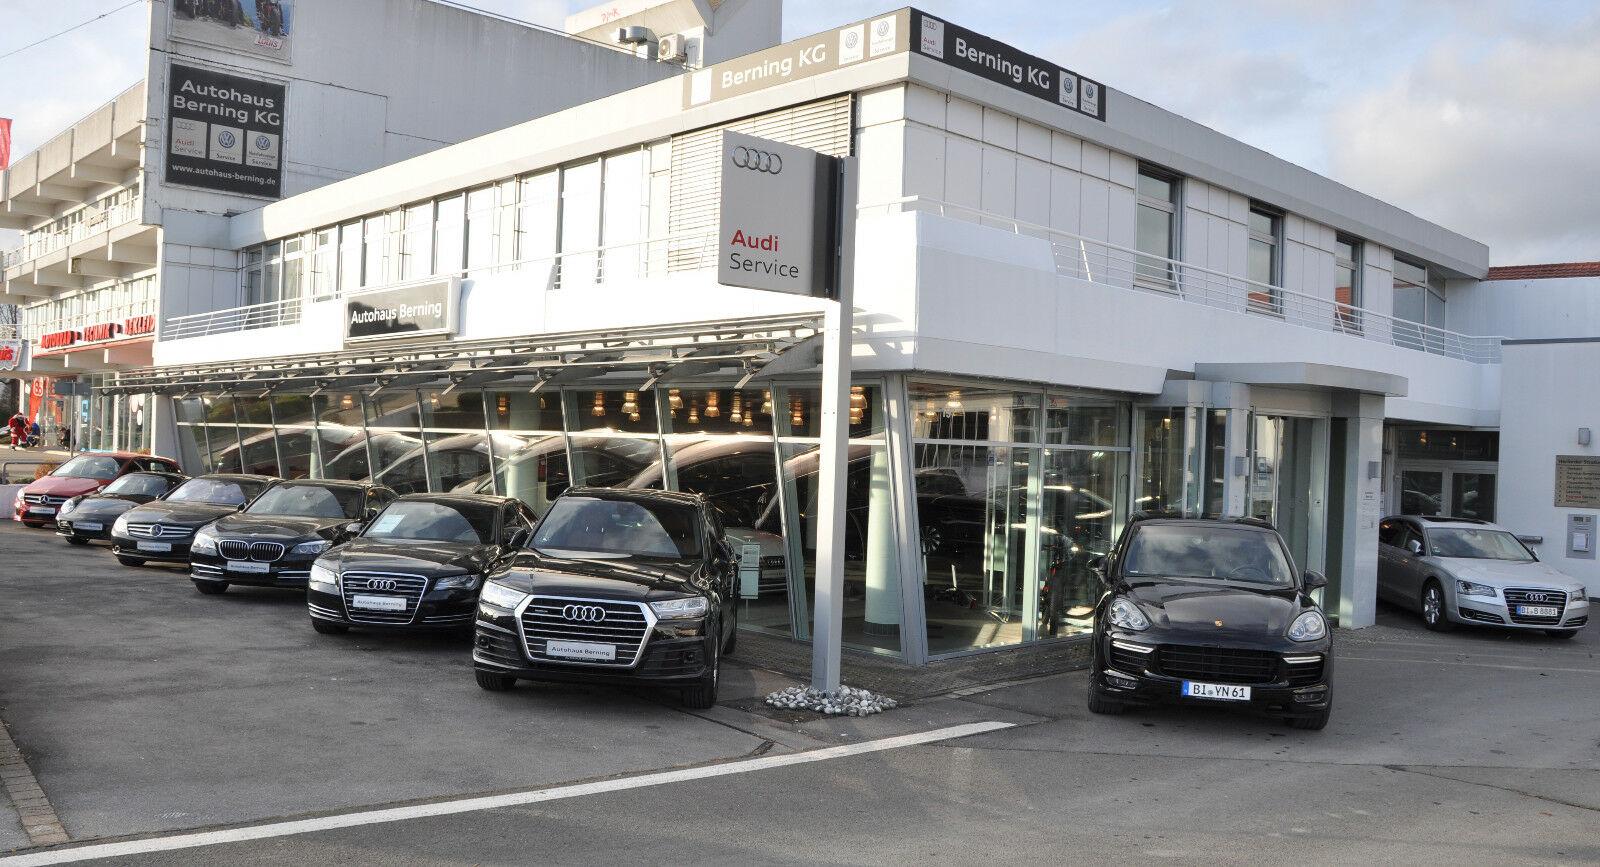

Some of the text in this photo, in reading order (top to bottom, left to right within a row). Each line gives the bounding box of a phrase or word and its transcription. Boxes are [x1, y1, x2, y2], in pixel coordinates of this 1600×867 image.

[722, 43, 826, 88] Berning KG
[955, 37, 1050, 89] Berning KG
[180, 79, 274, 108] Autohaus
[173, 95, 280, 126] Berning KG
[172, 163, 276, 186] www.autohaus-berning.de
[731, 229, 779, 252] Audi
[729, 252, 799, 279] Service
[351, 300, 441, 324] Autohaus Berning
[551, 646, 610, 657] Autohaus Berning
[1193, 684, 1245, 698] BI YN 61
